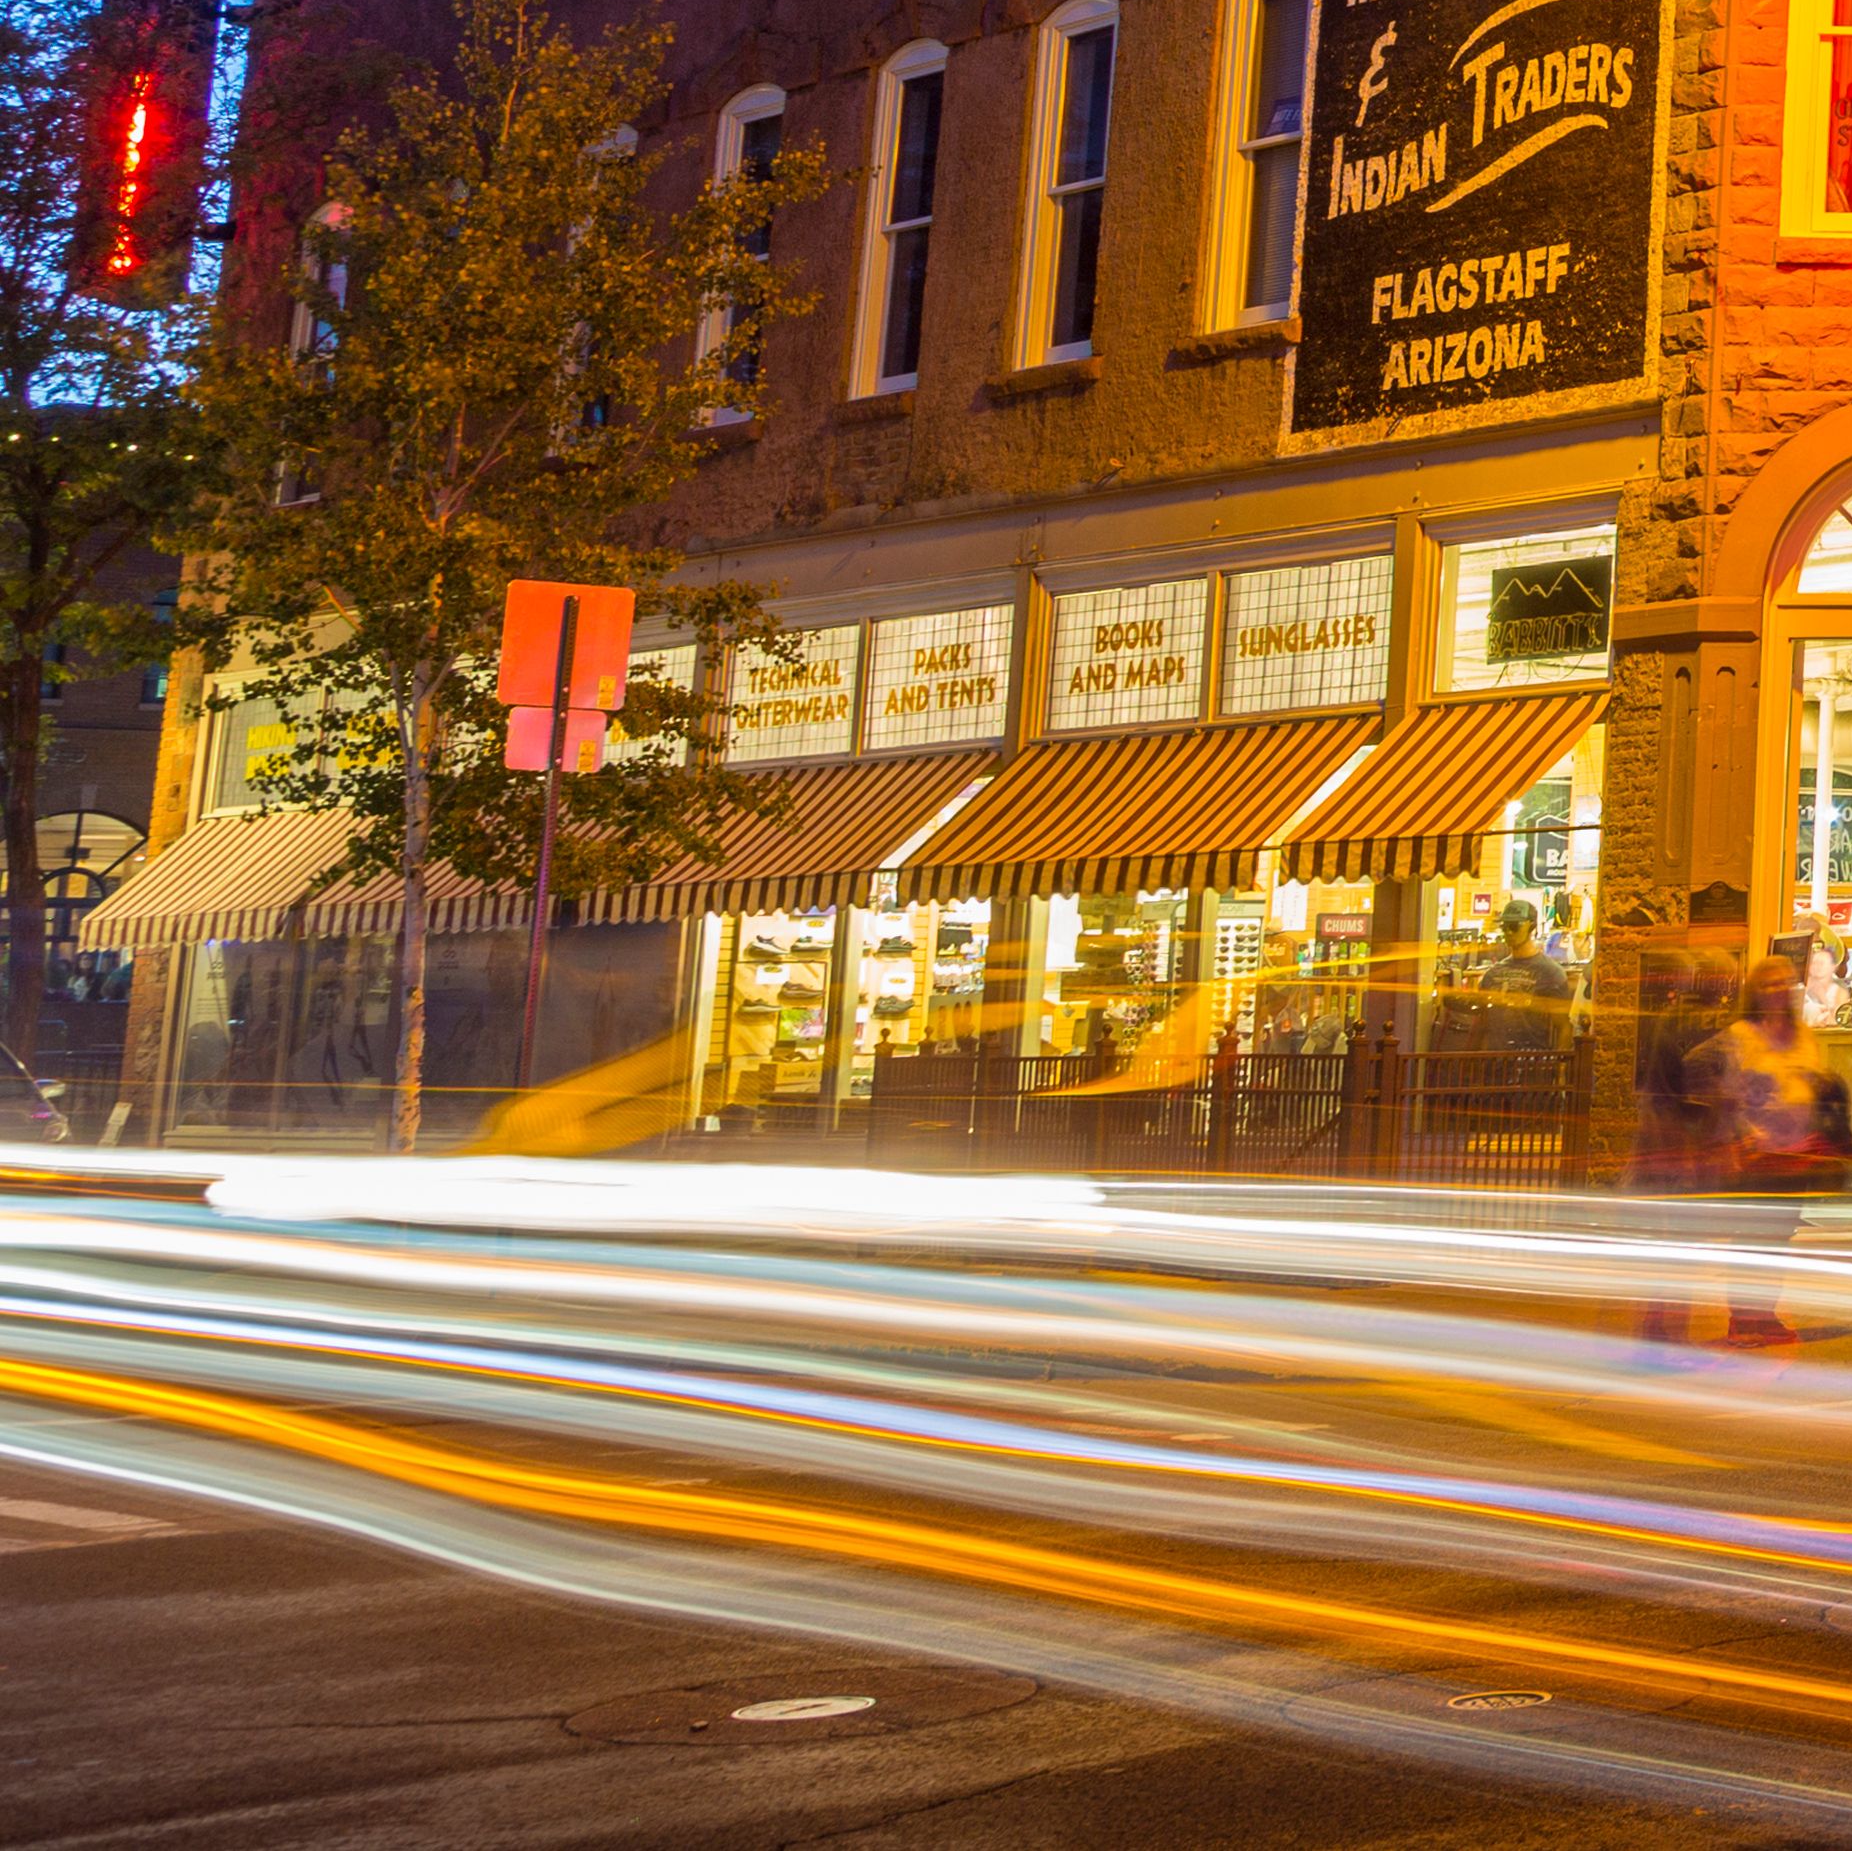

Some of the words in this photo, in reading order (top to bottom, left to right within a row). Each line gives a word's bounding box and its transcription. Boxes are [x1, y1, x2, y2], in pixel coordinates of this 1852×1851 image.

[1355, 21, 1398, 128] &
[1371, 241, 1572, 325] FLAGSTAFF
[1382, 319, 1548, 391] ARIZONA
[1094, 619, 1164, 653] BOOKS
[1238, 614, 1377, 659] SUNGLASSES
[748, 659, 842, 695] TECHNICAL
[914, 643, 971, 677] PACKS
[1069, 663, 1117, 694] AND
[1125, 656, 1185, 689] MAPS
[885, 687, 929, 716] AND
[936, 678, 997, 709] TENTS
[1324, 918, 1365, 935] CHUMS
